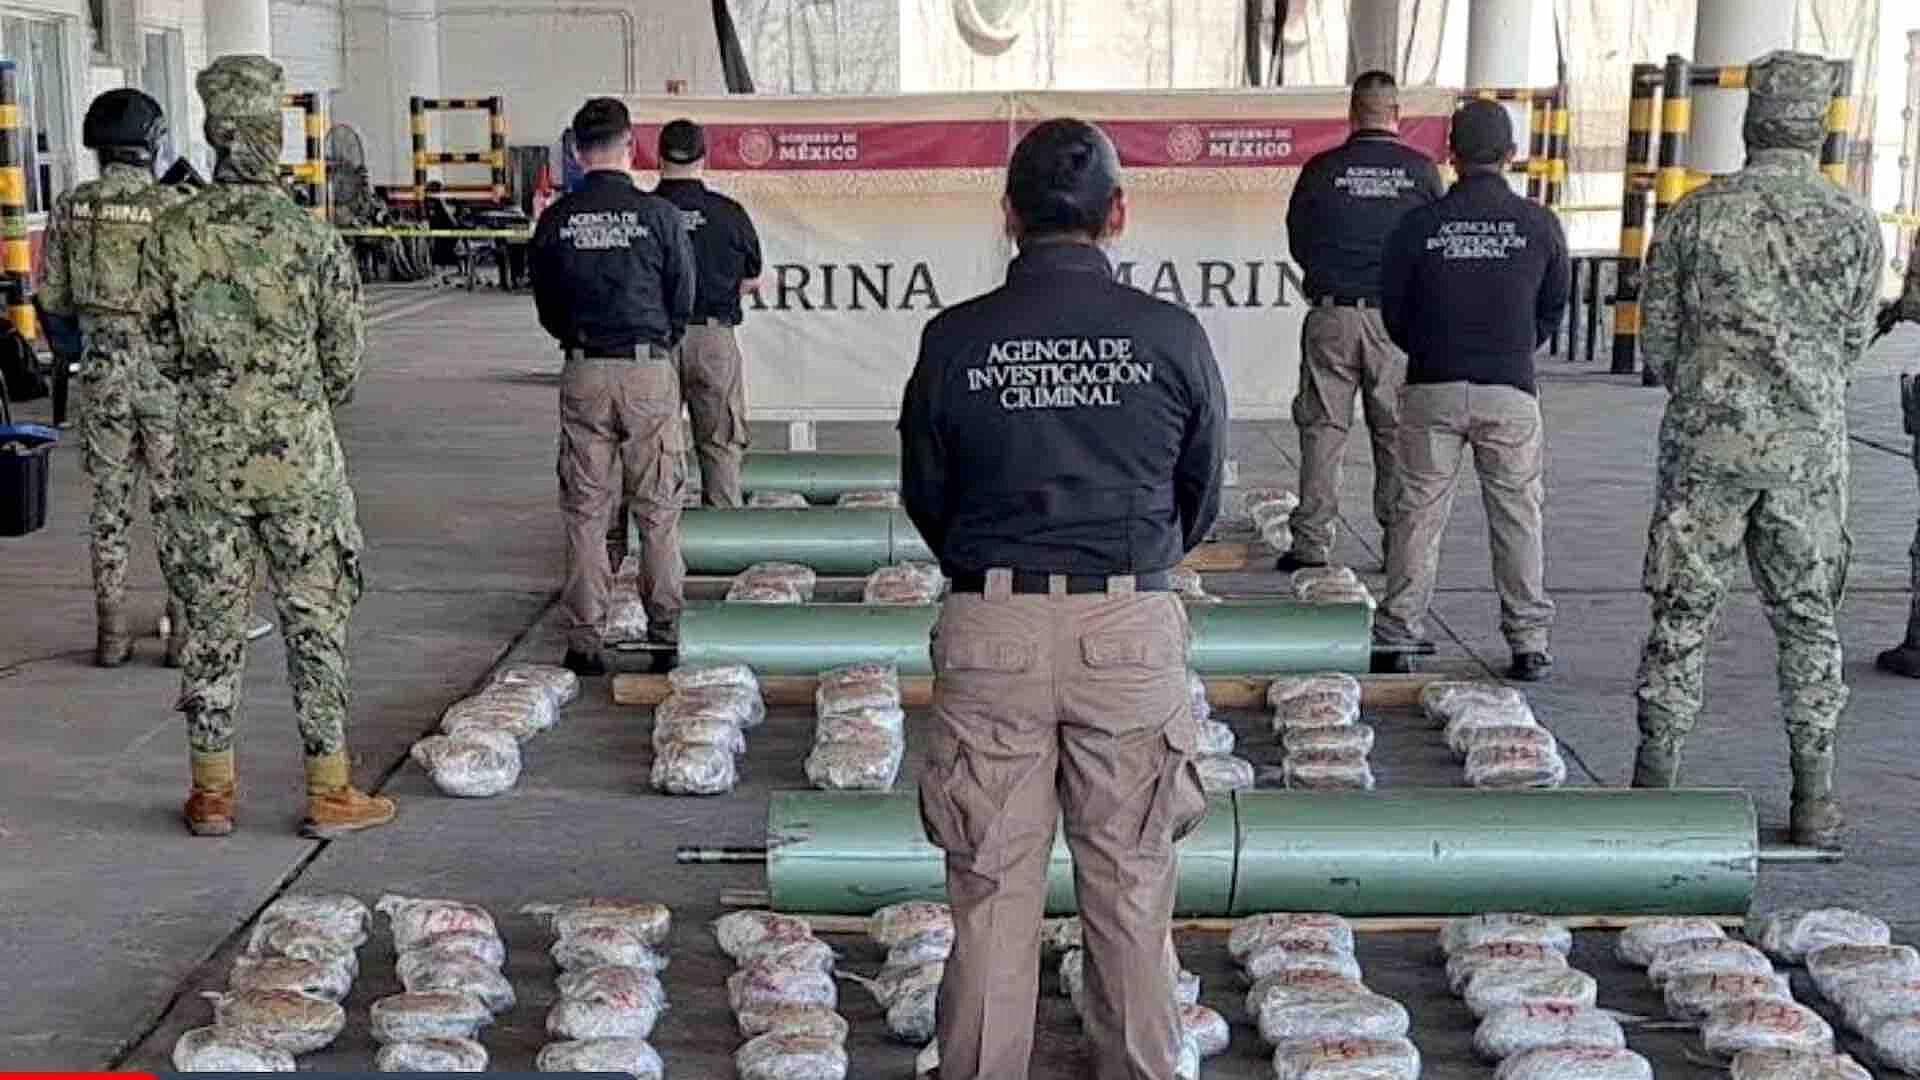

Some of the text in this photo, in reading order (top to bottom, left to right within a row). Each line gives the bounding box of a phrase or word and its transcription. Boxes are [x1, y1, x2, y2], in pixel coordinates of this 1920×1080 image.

[779, 143, 857, 160] MÉXICO
[1208, 140, 1291, 157] MÉXICO
[72, 201, 153, 221] MRINA
[987, 338, 1132, 363] AGENCIA DE
[967, 360, 1153, 390] INVESTIGACIÓN
[1001, 385, 1120, 409] CRIMINAL
